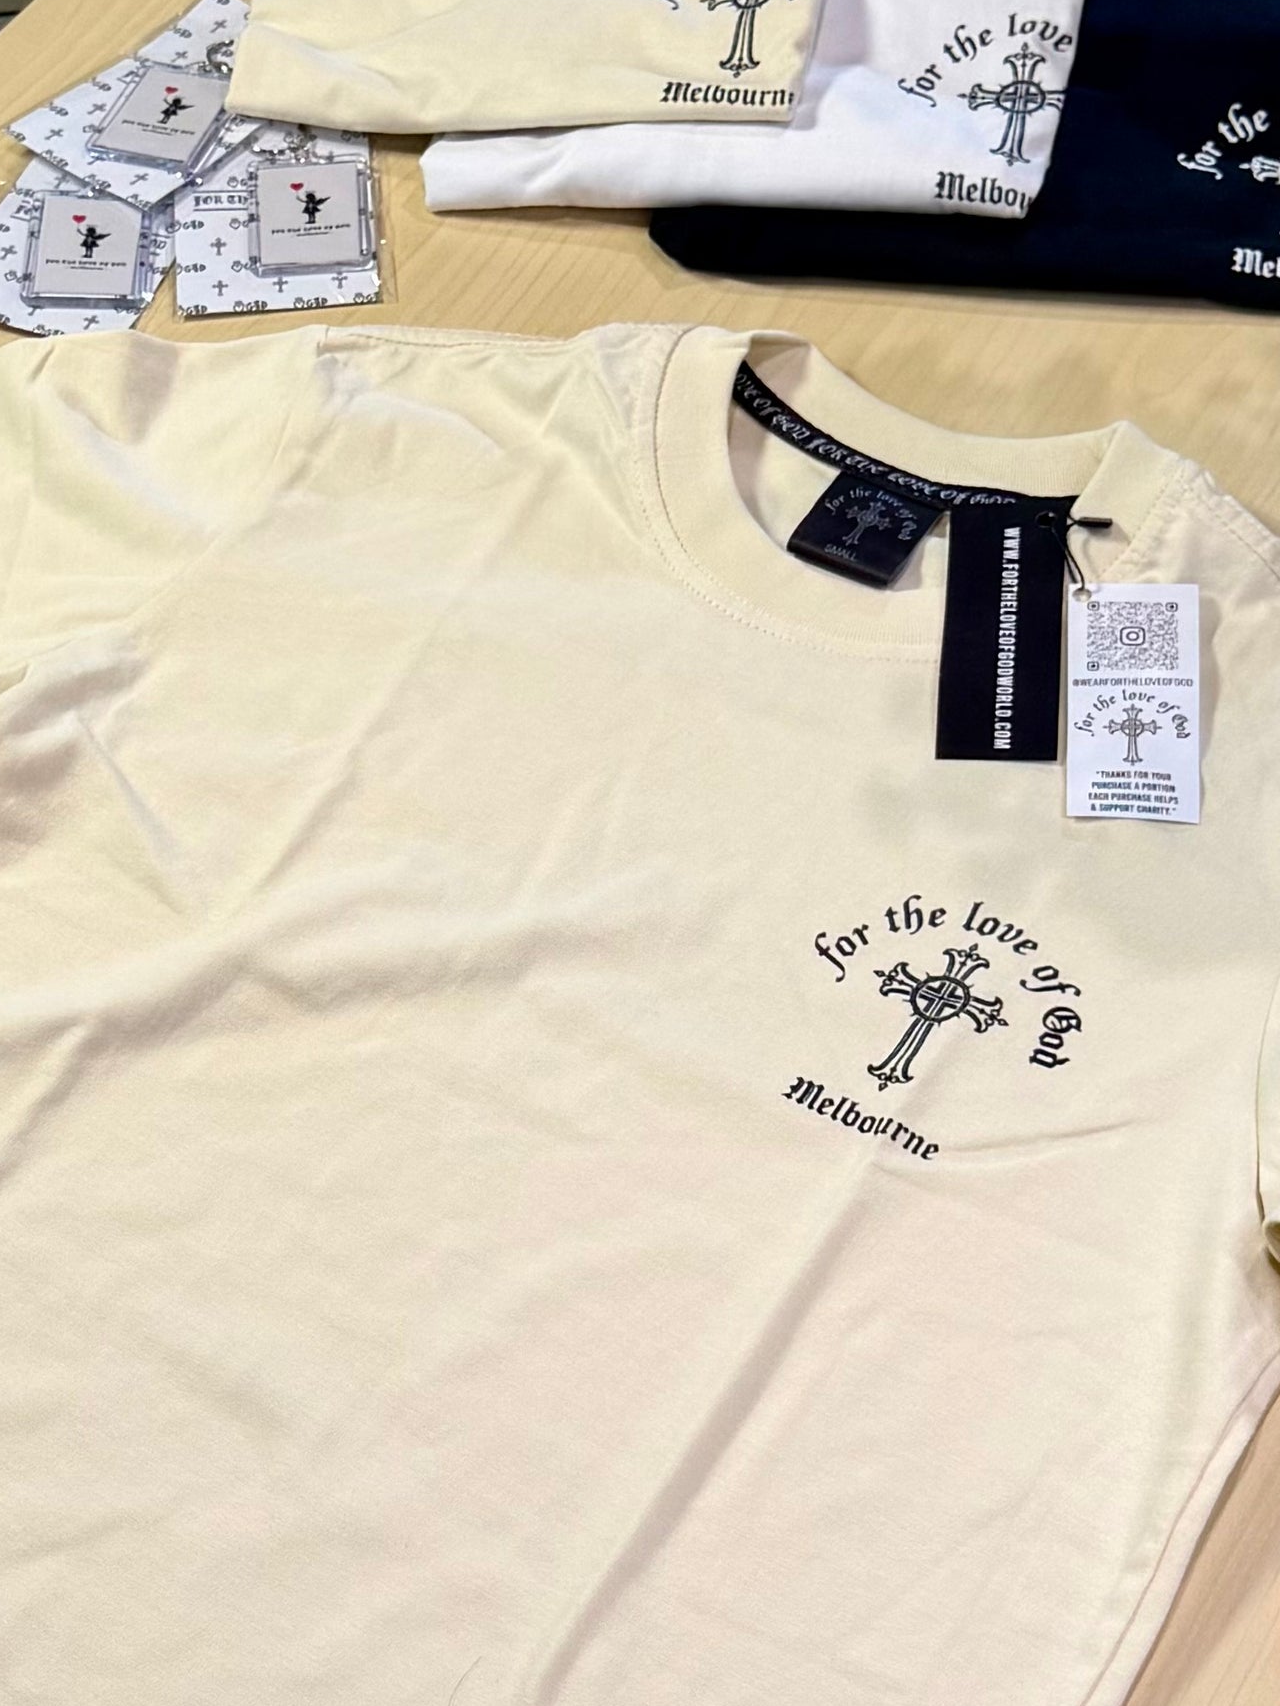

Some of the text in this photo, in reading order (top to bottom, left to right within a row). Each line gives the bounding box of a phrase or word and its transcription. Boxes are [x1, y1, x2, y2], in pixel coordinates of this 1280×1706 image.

[660, 81, 794, 107] Melbourn
[897, 12, 1072, 108] for the love
[1176, 138, 1223, 180] for
[1218, 102, 1269, 144] the
[992, 527, 1022, 751] WWW.FORTHELOVEOFGODWORLD.COM
[1073, 712, 1097, 737] for
[1092, 694, 1117, 713] the
[1121, 688, 1157, 703] love
[1155, 701, 1181, 715] of
[814, 894, 1083, 1069] for the love of God
[781, 1075, 940, 1161] Melbourne
